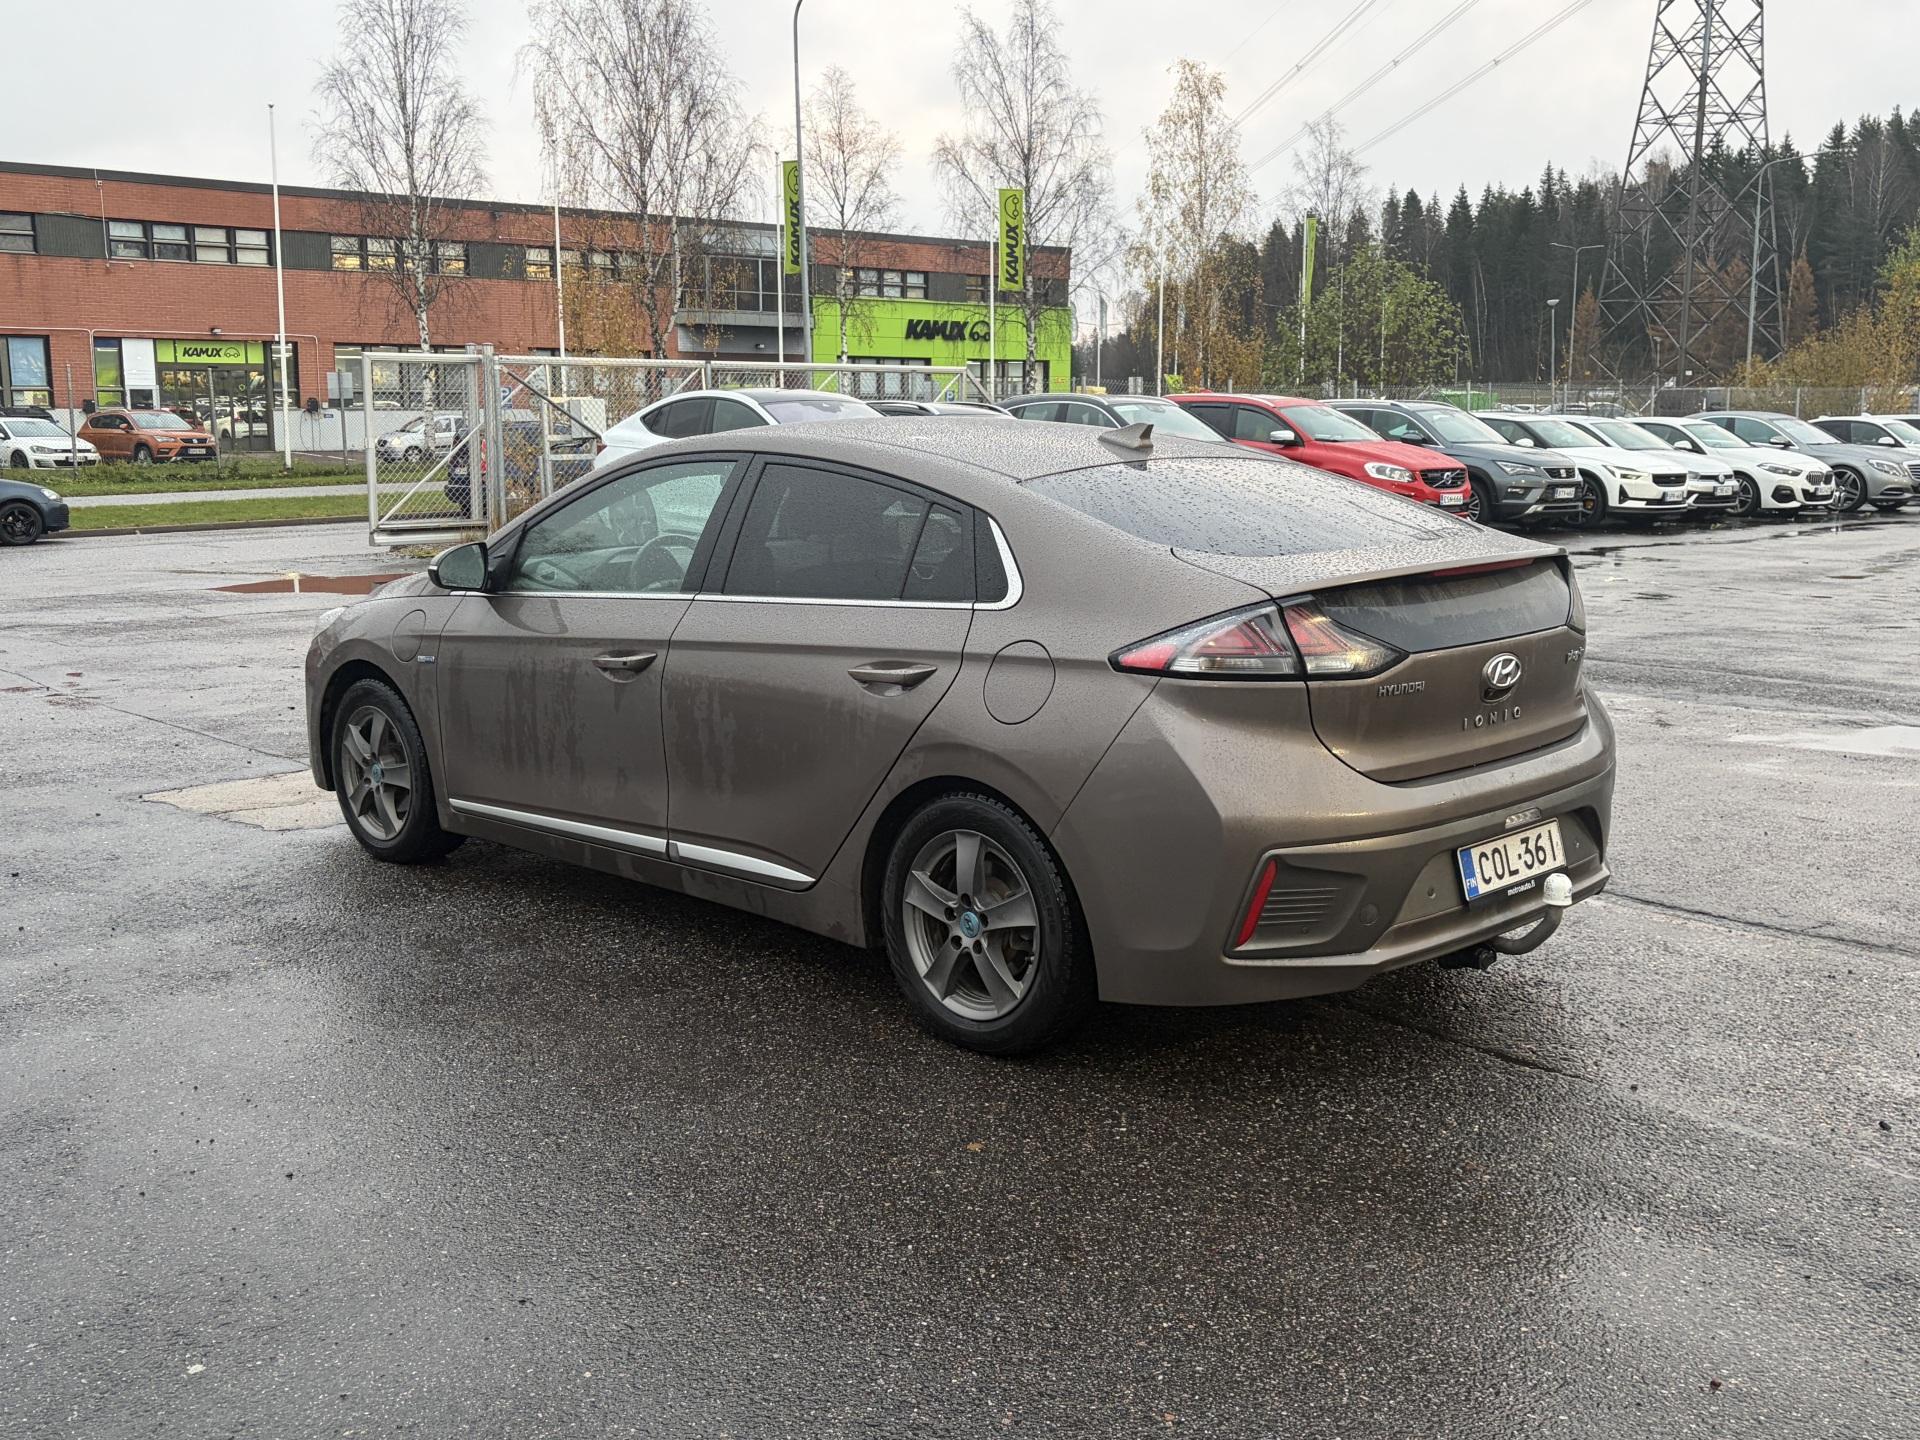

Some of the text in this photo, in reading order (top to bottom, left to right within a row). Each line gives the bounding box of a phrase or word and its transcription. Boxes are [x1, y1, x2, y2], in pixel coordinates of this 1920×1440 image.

[789, 195, 800, 267] KAMUX
[1005, 221, 1020, 285] KAMUX
[905, 318, 969, 341] KAMUX
[182, 346, 222, 358] KAMUX
[1378, 681, 1425, 697] HYUNDAI
[1463, 706, 1522, 731] IONIQ
[1466, 829, 1557, 890] FIN COL-361
